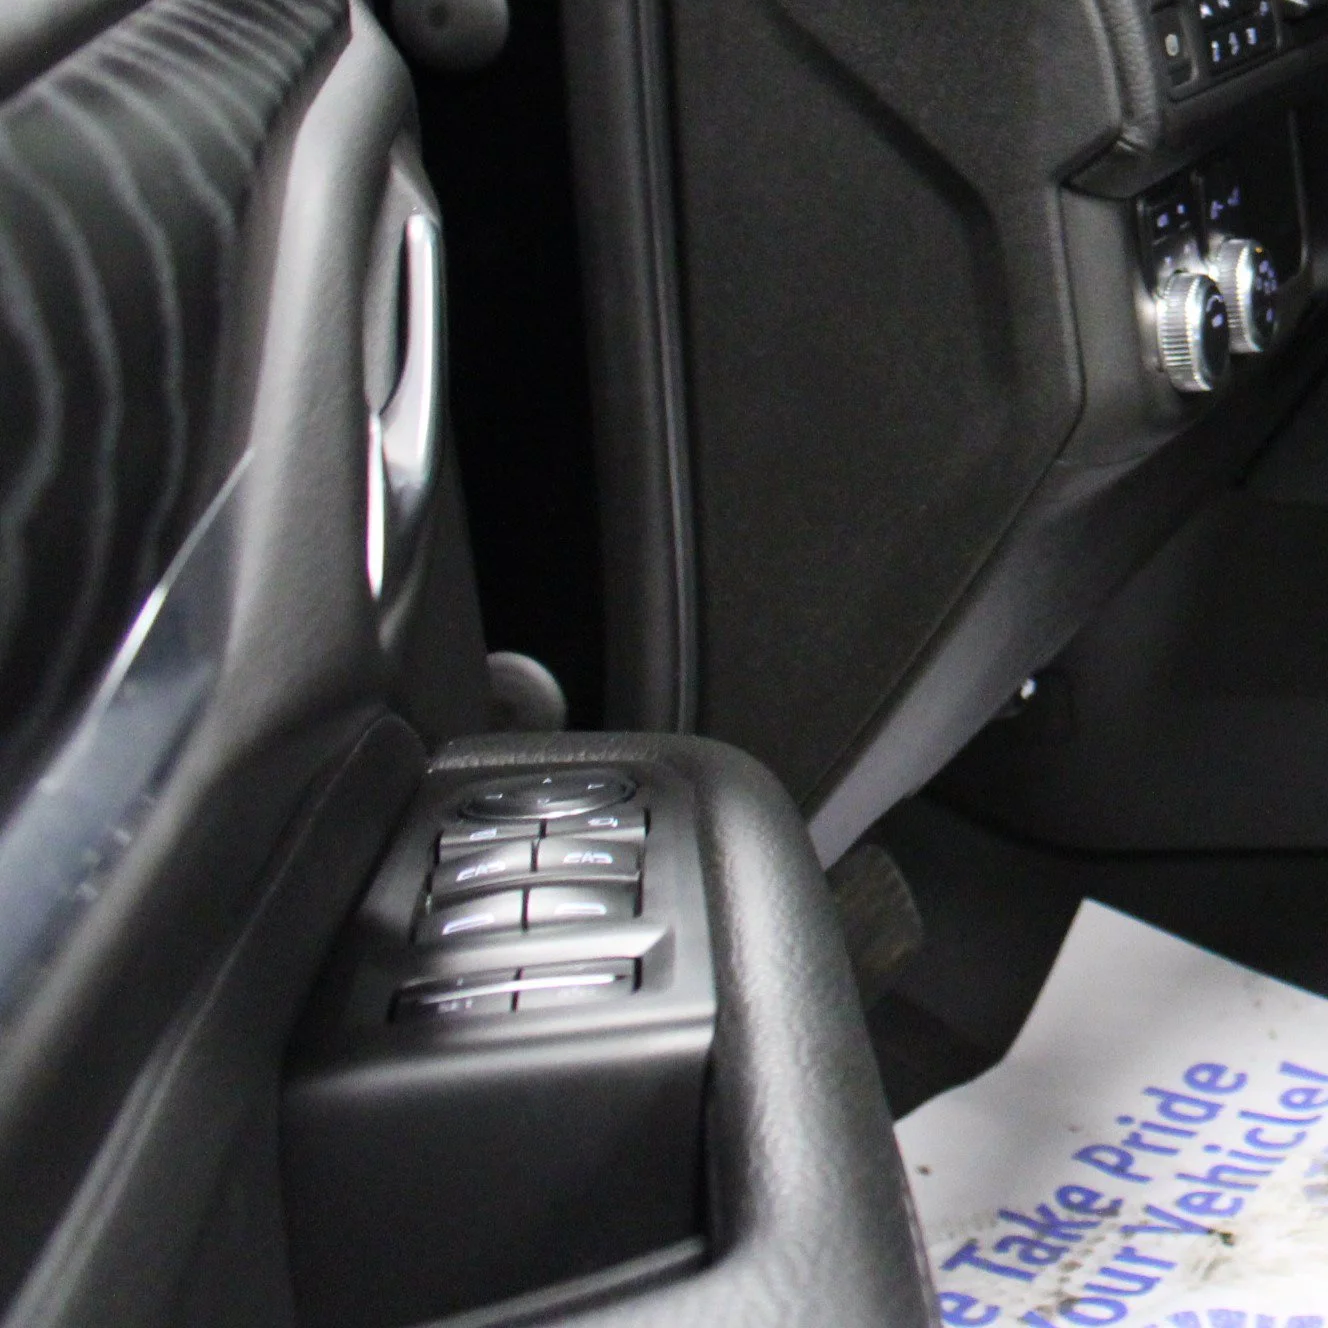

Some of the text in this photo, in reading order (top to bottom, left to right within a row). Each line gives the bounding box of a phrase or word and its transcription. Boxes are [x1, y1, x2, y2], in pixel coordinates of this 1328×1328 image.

[938, 1061, 1248, 1327] e Take Pride
